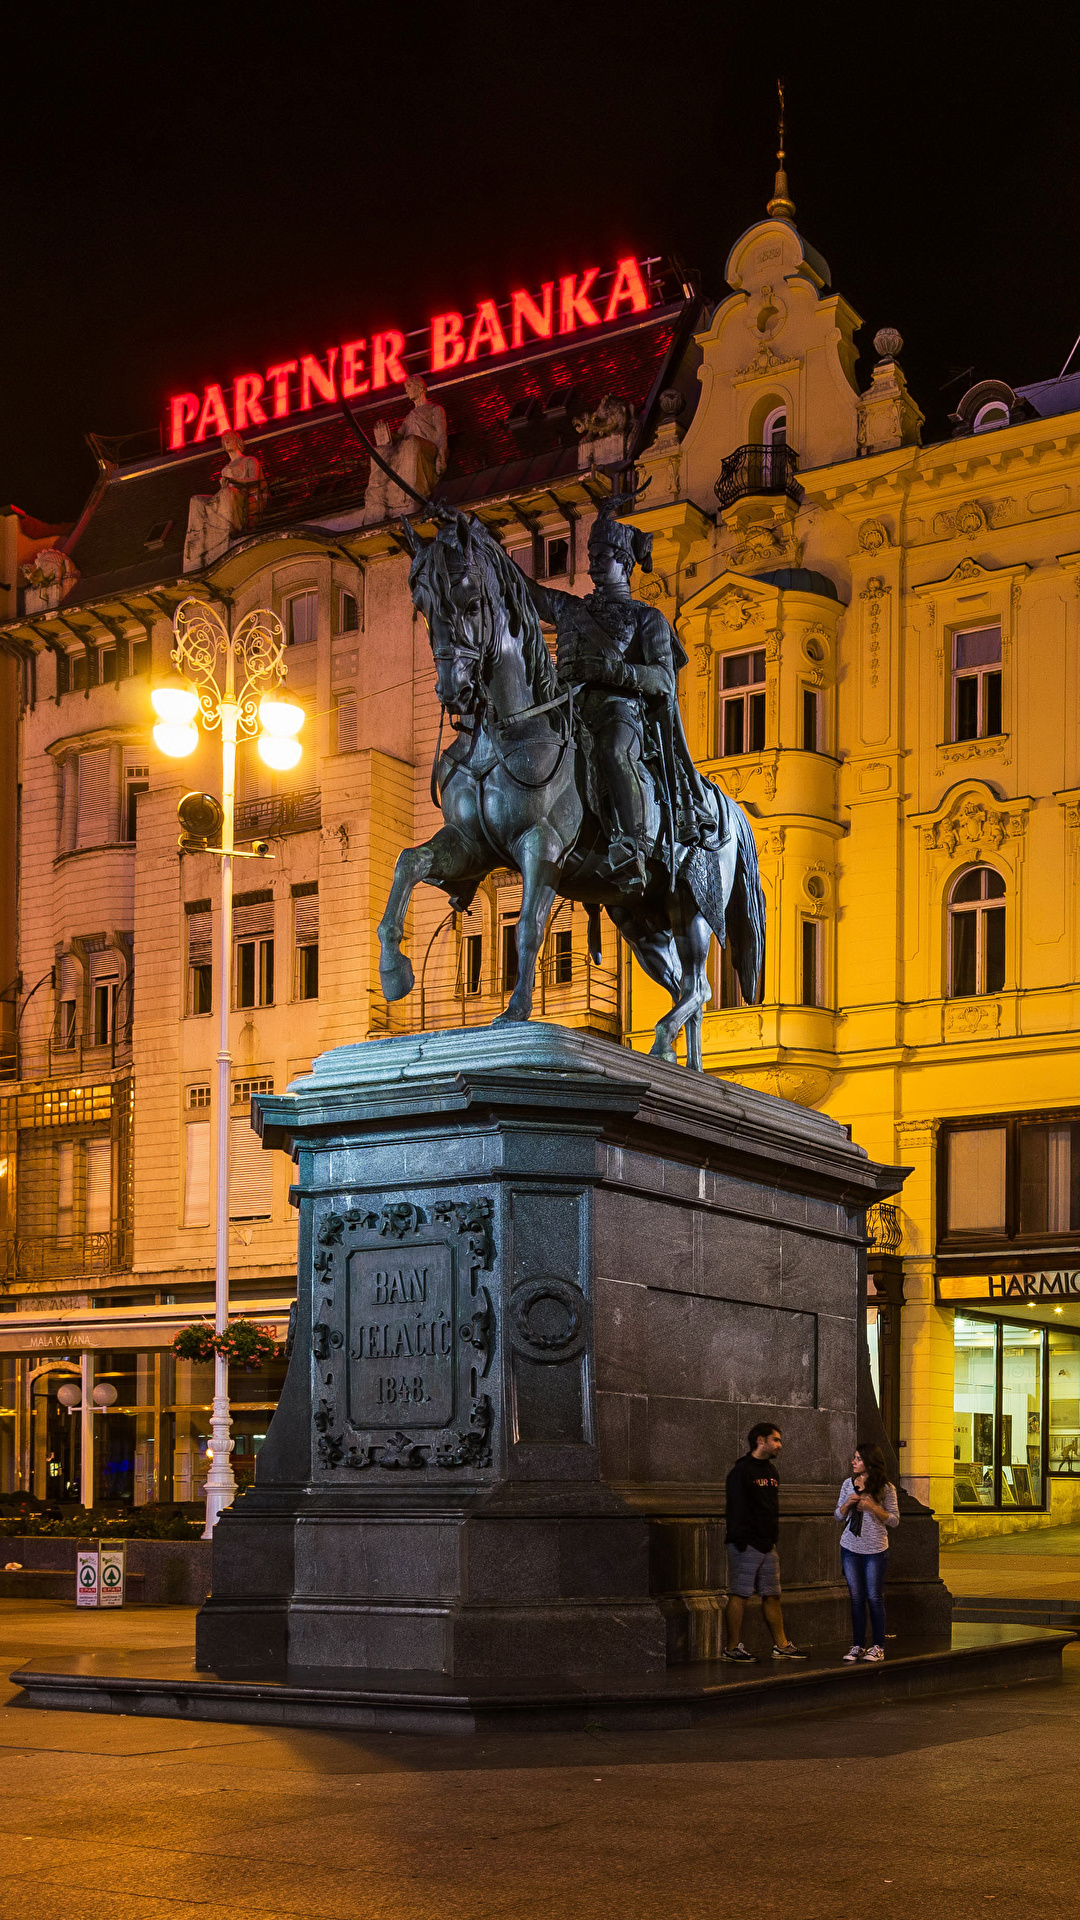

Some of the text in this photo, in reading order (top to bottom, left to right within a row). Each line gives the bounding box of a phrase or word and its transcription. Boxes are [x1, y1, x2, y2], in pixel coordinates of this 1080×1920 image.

[168, 255, 651, 450] PARTNER BANKA
[371, 1267, 428, 1305] BAN
[30, 1335, 91, 1347] MALA KAVANA
[351, 1310, 451, 1360] JELAČIĆ
